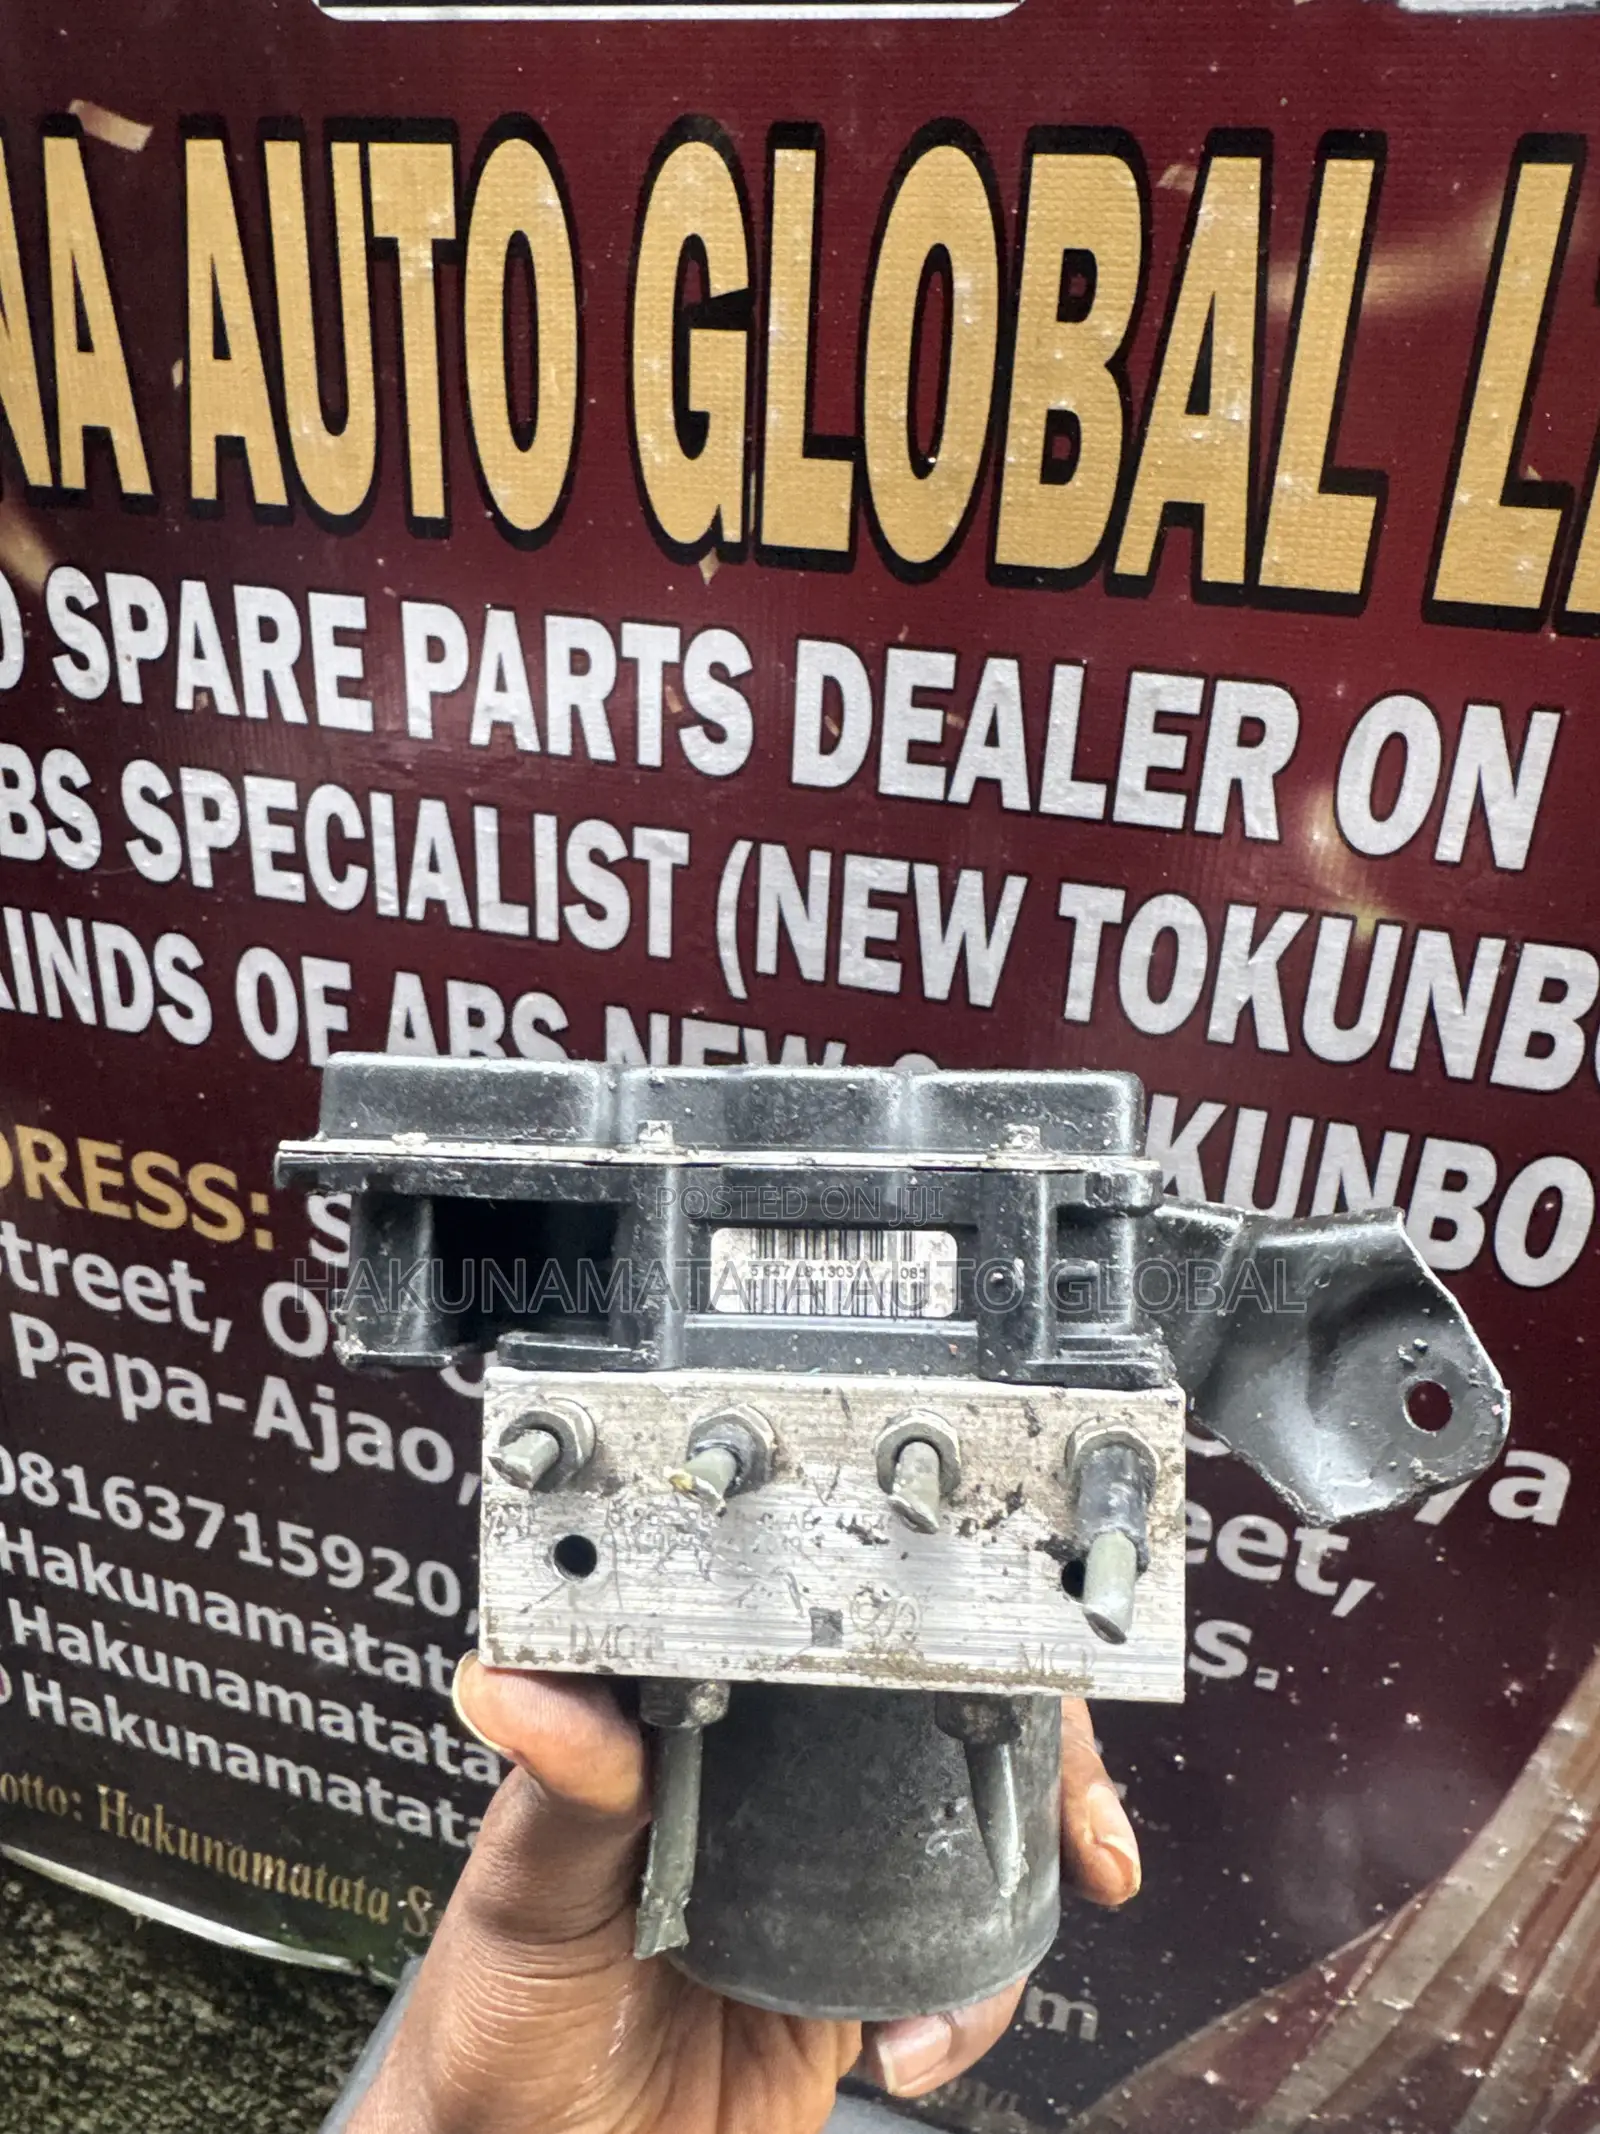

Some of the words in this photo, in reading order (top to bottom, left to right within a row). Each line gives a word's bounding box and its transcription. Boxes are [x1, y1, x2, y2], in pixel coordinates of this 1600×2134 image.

[185, 137, 577, 532] AUTO
[632, 140, 1377, 595] GLOBAL
[45, 566, 374, 732] SPARE
[400, 600, 754, 777] PARTS
[791, 638, 1300, 842] DEALER
[1336, 695, 1562, 871] ON
[0, 907, 213, 1045] INDS
[236, 946, 352, 1067] OF
[121, 759, 691, 960] SPECIALIST
[716, 839, 1028, 1008] (NEW
[1058, 881, 1600, 1092] TOKUNB
[9, 1311, 481, 1506] Papa-Ajao,
[8, 1597, 501, 1786] Hakunamatata
[97, 1783, 390, 1926] Hakunamatata
